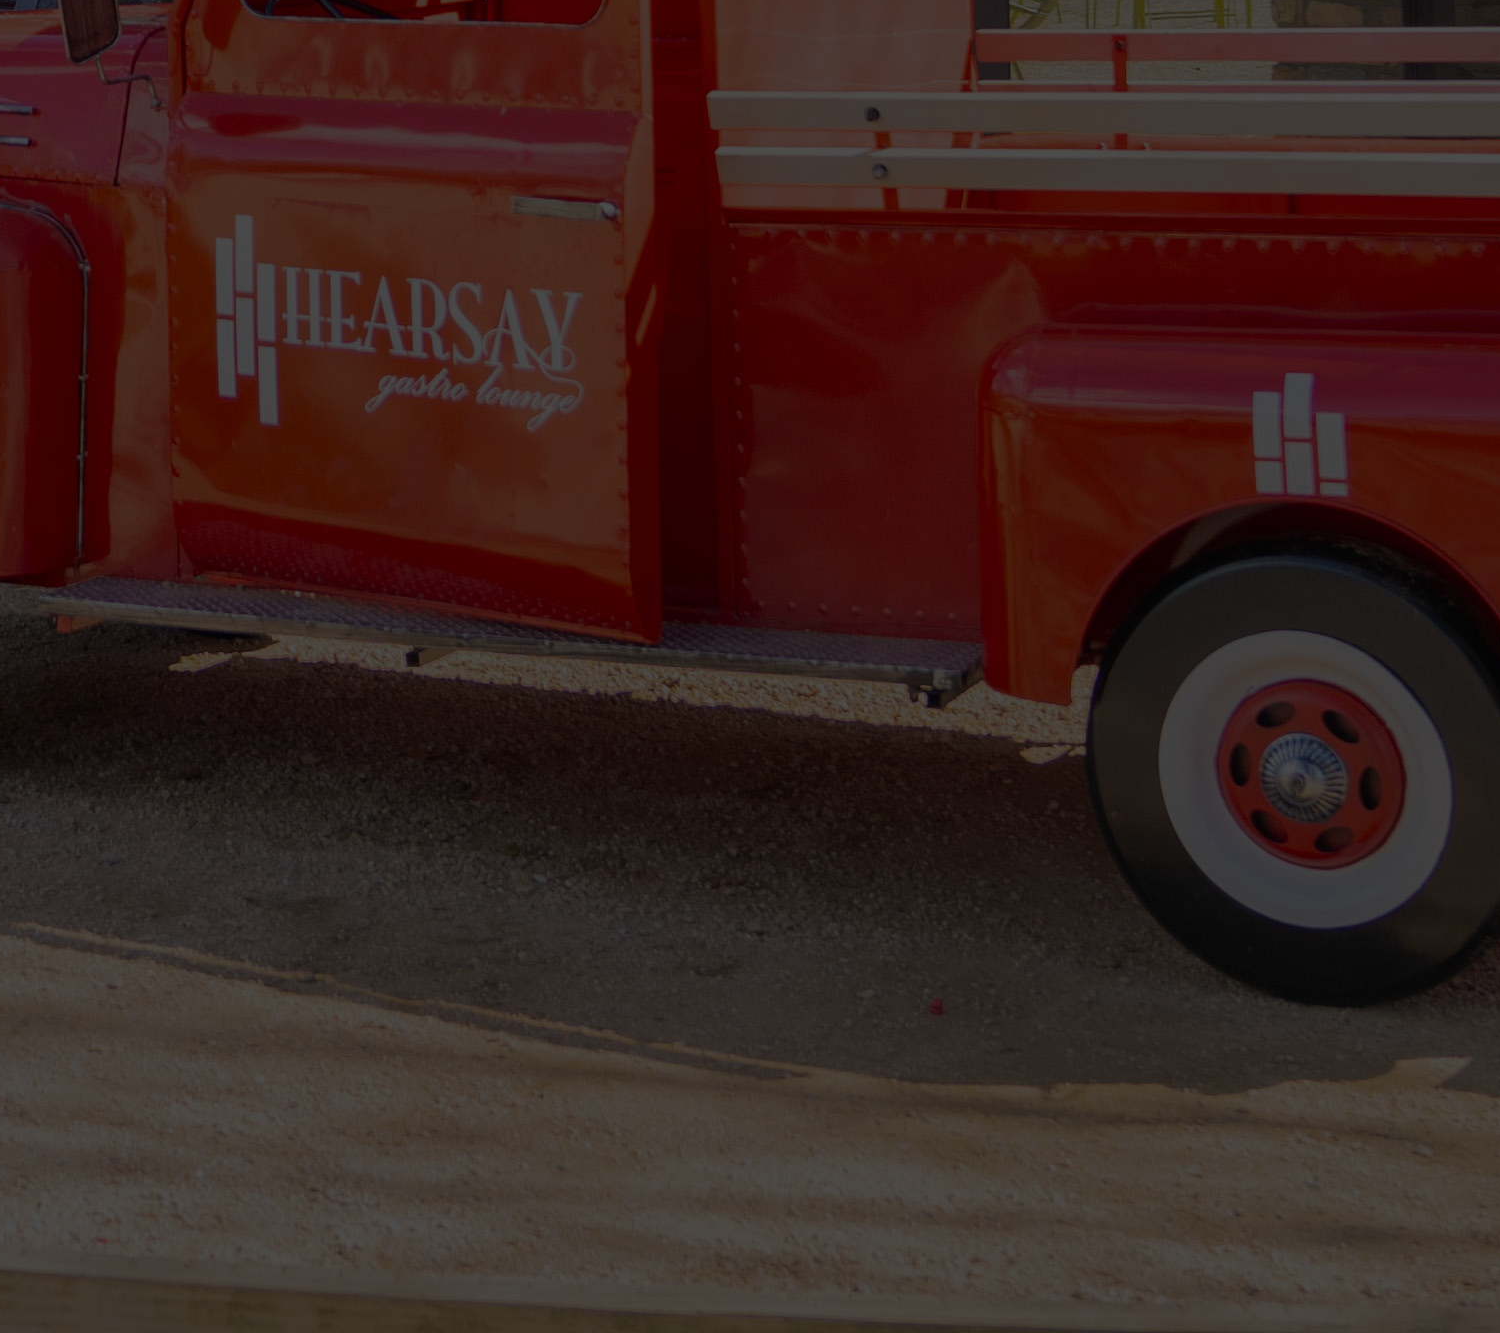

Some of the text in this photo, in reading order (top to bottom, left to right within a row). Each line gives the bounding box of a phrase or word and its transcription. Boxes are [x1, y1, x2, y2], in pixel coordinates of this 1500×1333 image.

[281, 265, 584, 373] HEARSAY
[365, 365, 584, 432] gastro lounge
